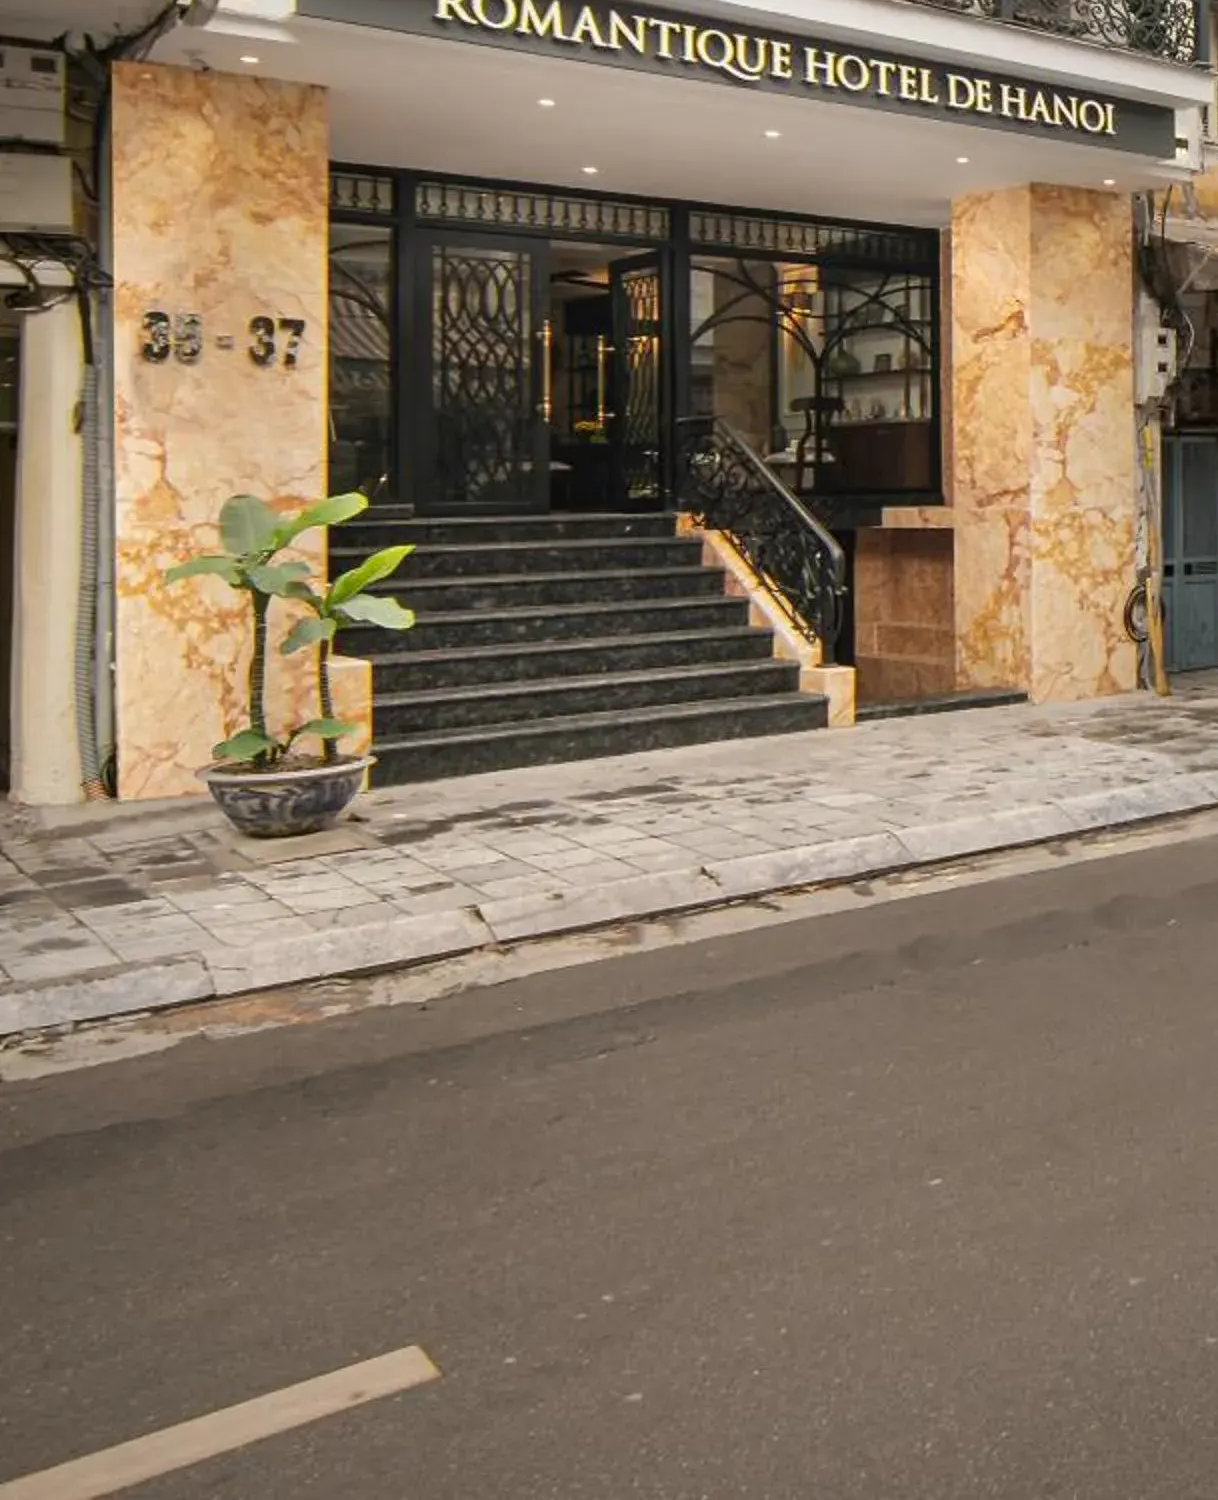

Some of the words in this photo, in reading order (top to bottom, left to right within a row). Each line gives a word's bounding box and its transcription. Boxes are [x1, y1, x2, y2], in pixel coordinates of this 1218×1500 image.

[803, 47, 939, 104] HOTEL
[946, 73, 993, 114] DE
[1000, 84, 1118, 135] HANOI
[249, 315, 306, 370] 37
